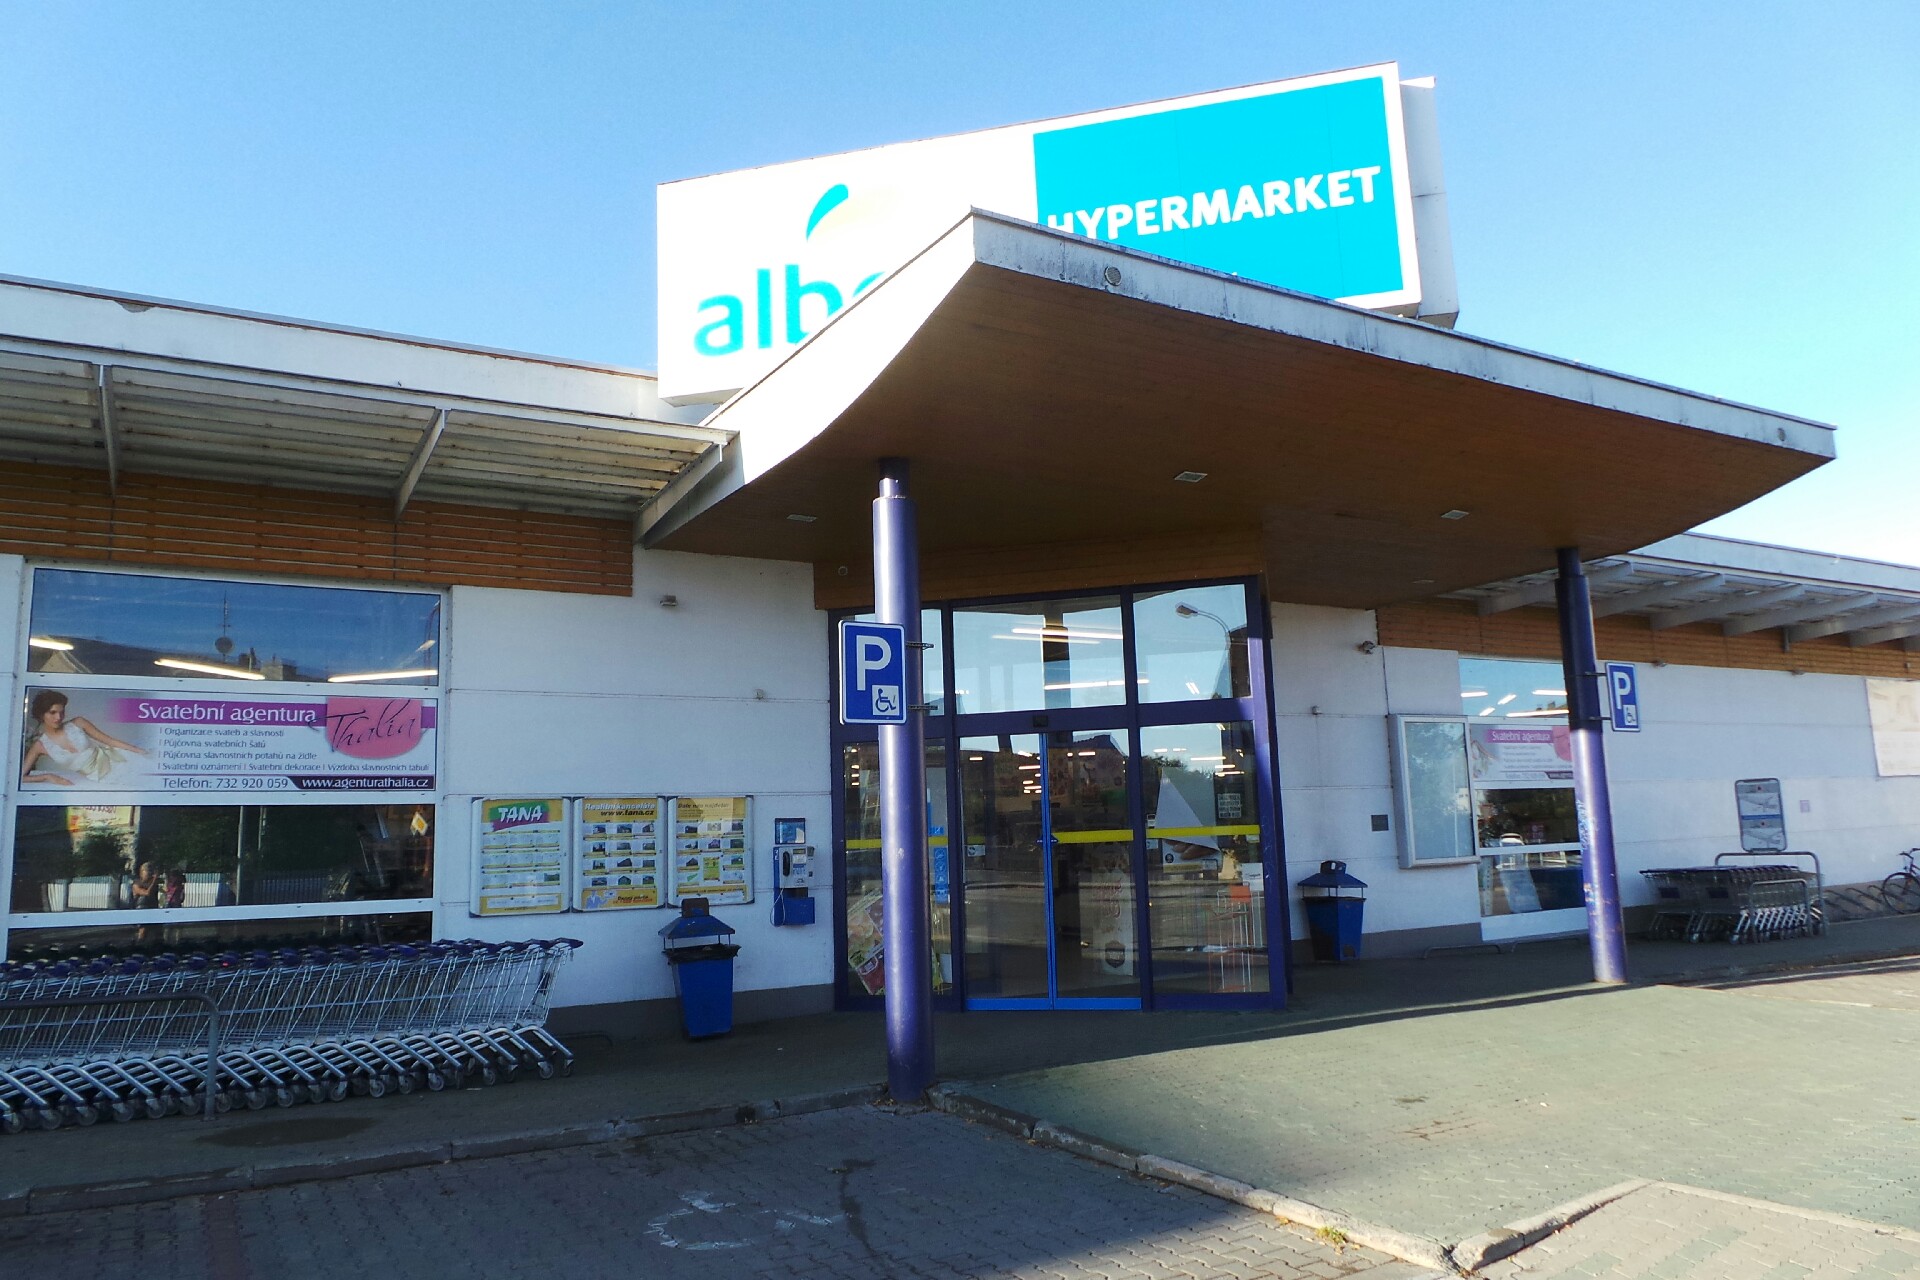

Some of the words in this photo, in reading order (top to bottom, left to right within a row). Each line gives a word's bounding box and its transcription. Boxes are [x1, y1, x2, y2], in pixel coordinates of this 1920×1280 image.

[694, 263, 885, 357] alb
[856, 634, 892, 691] P
[1613, 671, 1631, 710] P
[138, 702, 225, 720] Svatební
[230, 705, 317, 723] agentura
[164, 727, 212, 736] Organizace
[215, 728, 240, 736] svateb
[308, 699, 417, 752] Thalia
[204, 740, 247, 748] svatebních
[284, 763, 321, 771] dekorace
[162, 777, 212, 789] Telefon:
[216, 778, 237, 789] 732
[241, 778, 263, 789] 920
[267, 778, 289, 789] 059
[302, 777, 428, 789] www.agenturathalia.cz
[497, 805, 543, 823] TANA
